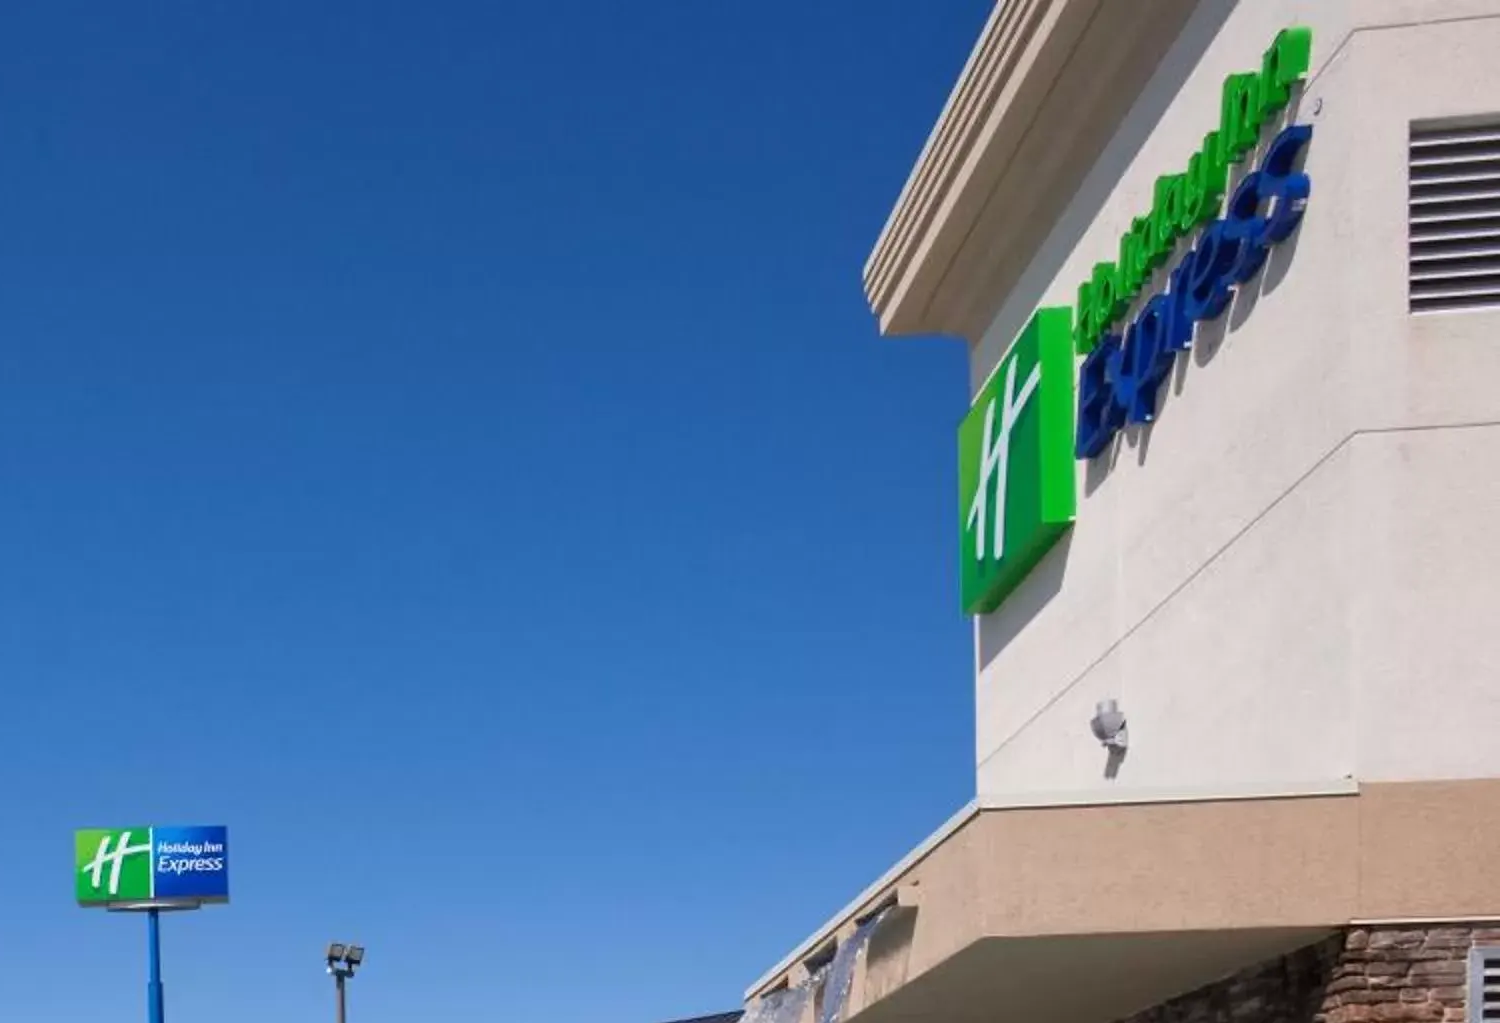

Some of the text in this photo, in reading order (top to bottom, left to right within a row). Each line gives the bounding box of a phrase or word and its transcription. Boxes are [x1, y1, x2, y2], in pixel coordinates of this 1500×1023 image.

[158, 840, 223, 856] Holiday Inn
[157, 856, 223, 875] Express
